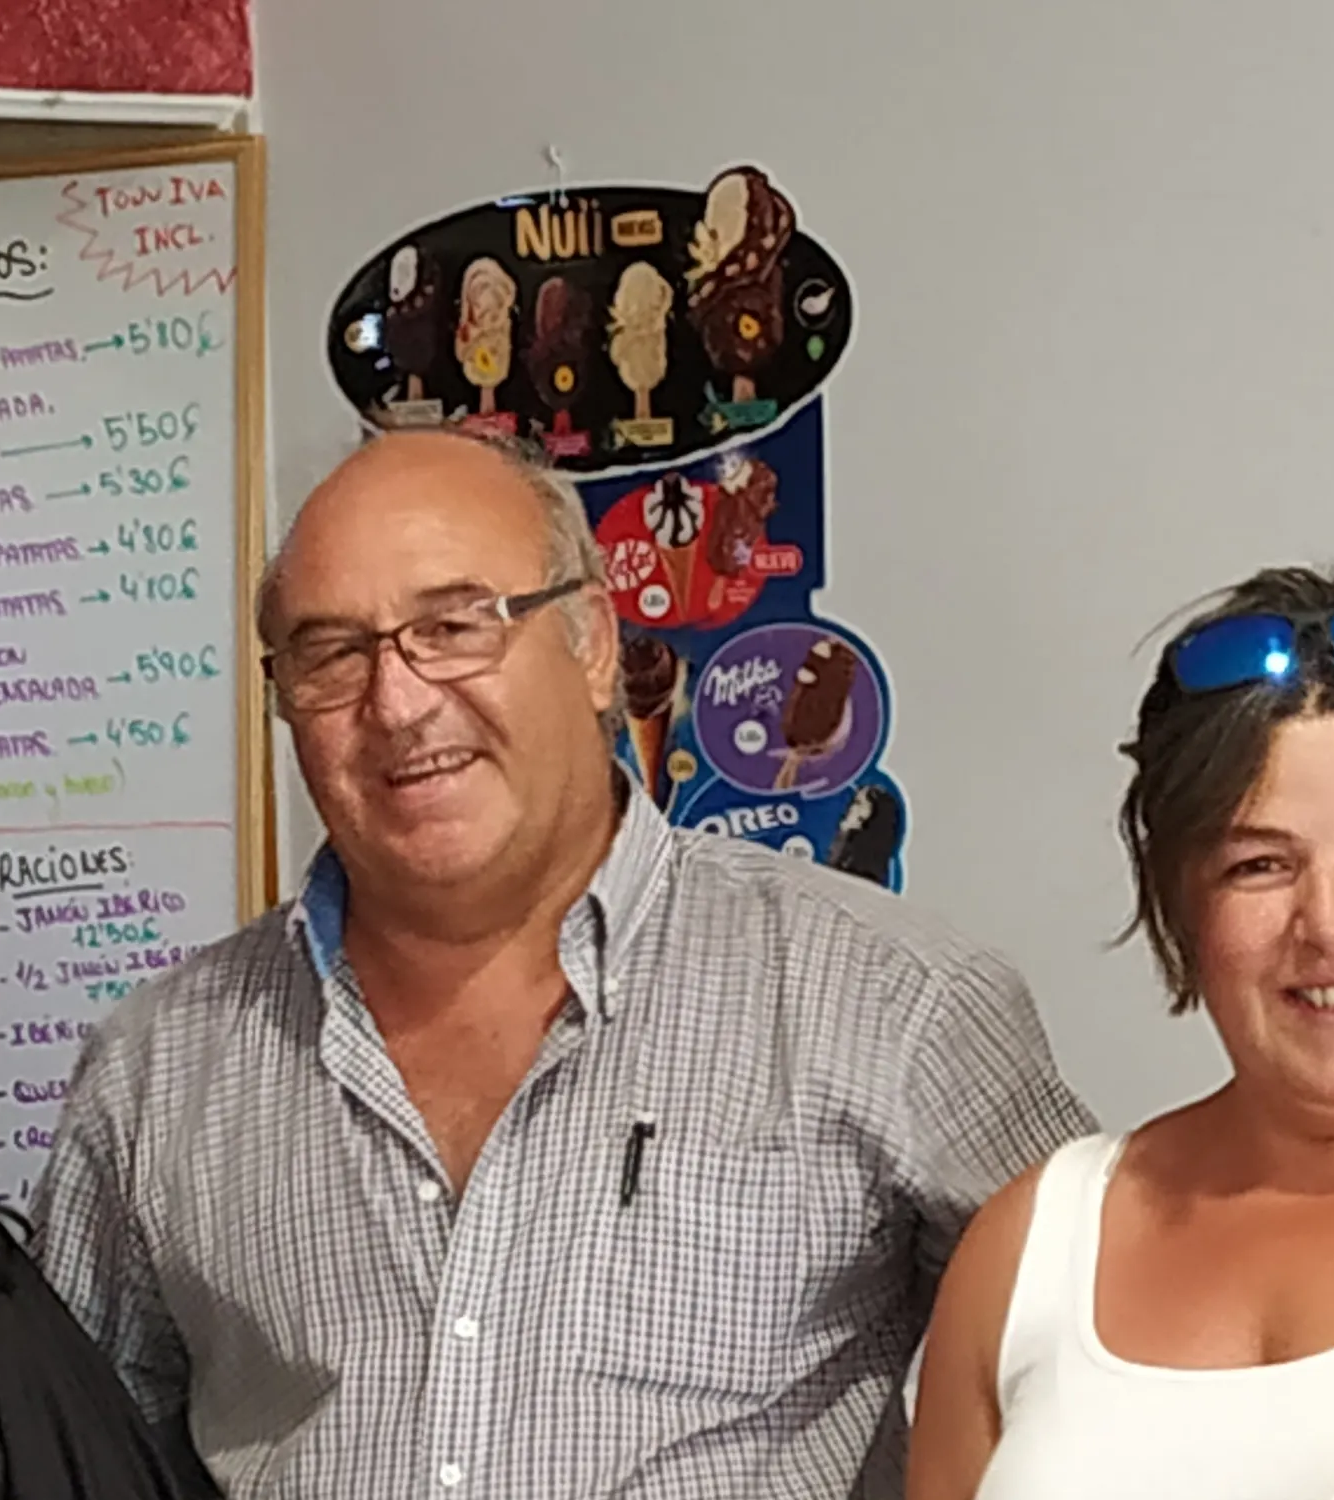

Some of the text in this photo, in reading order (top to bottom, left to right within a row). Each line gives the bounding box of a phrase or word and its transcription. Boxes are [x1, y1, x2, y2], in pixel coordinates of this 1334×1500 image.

[170, 176, 226, 205] IVA
[703, 655, 783, 707] Milka
[694, 801, 800, 838] OREO
